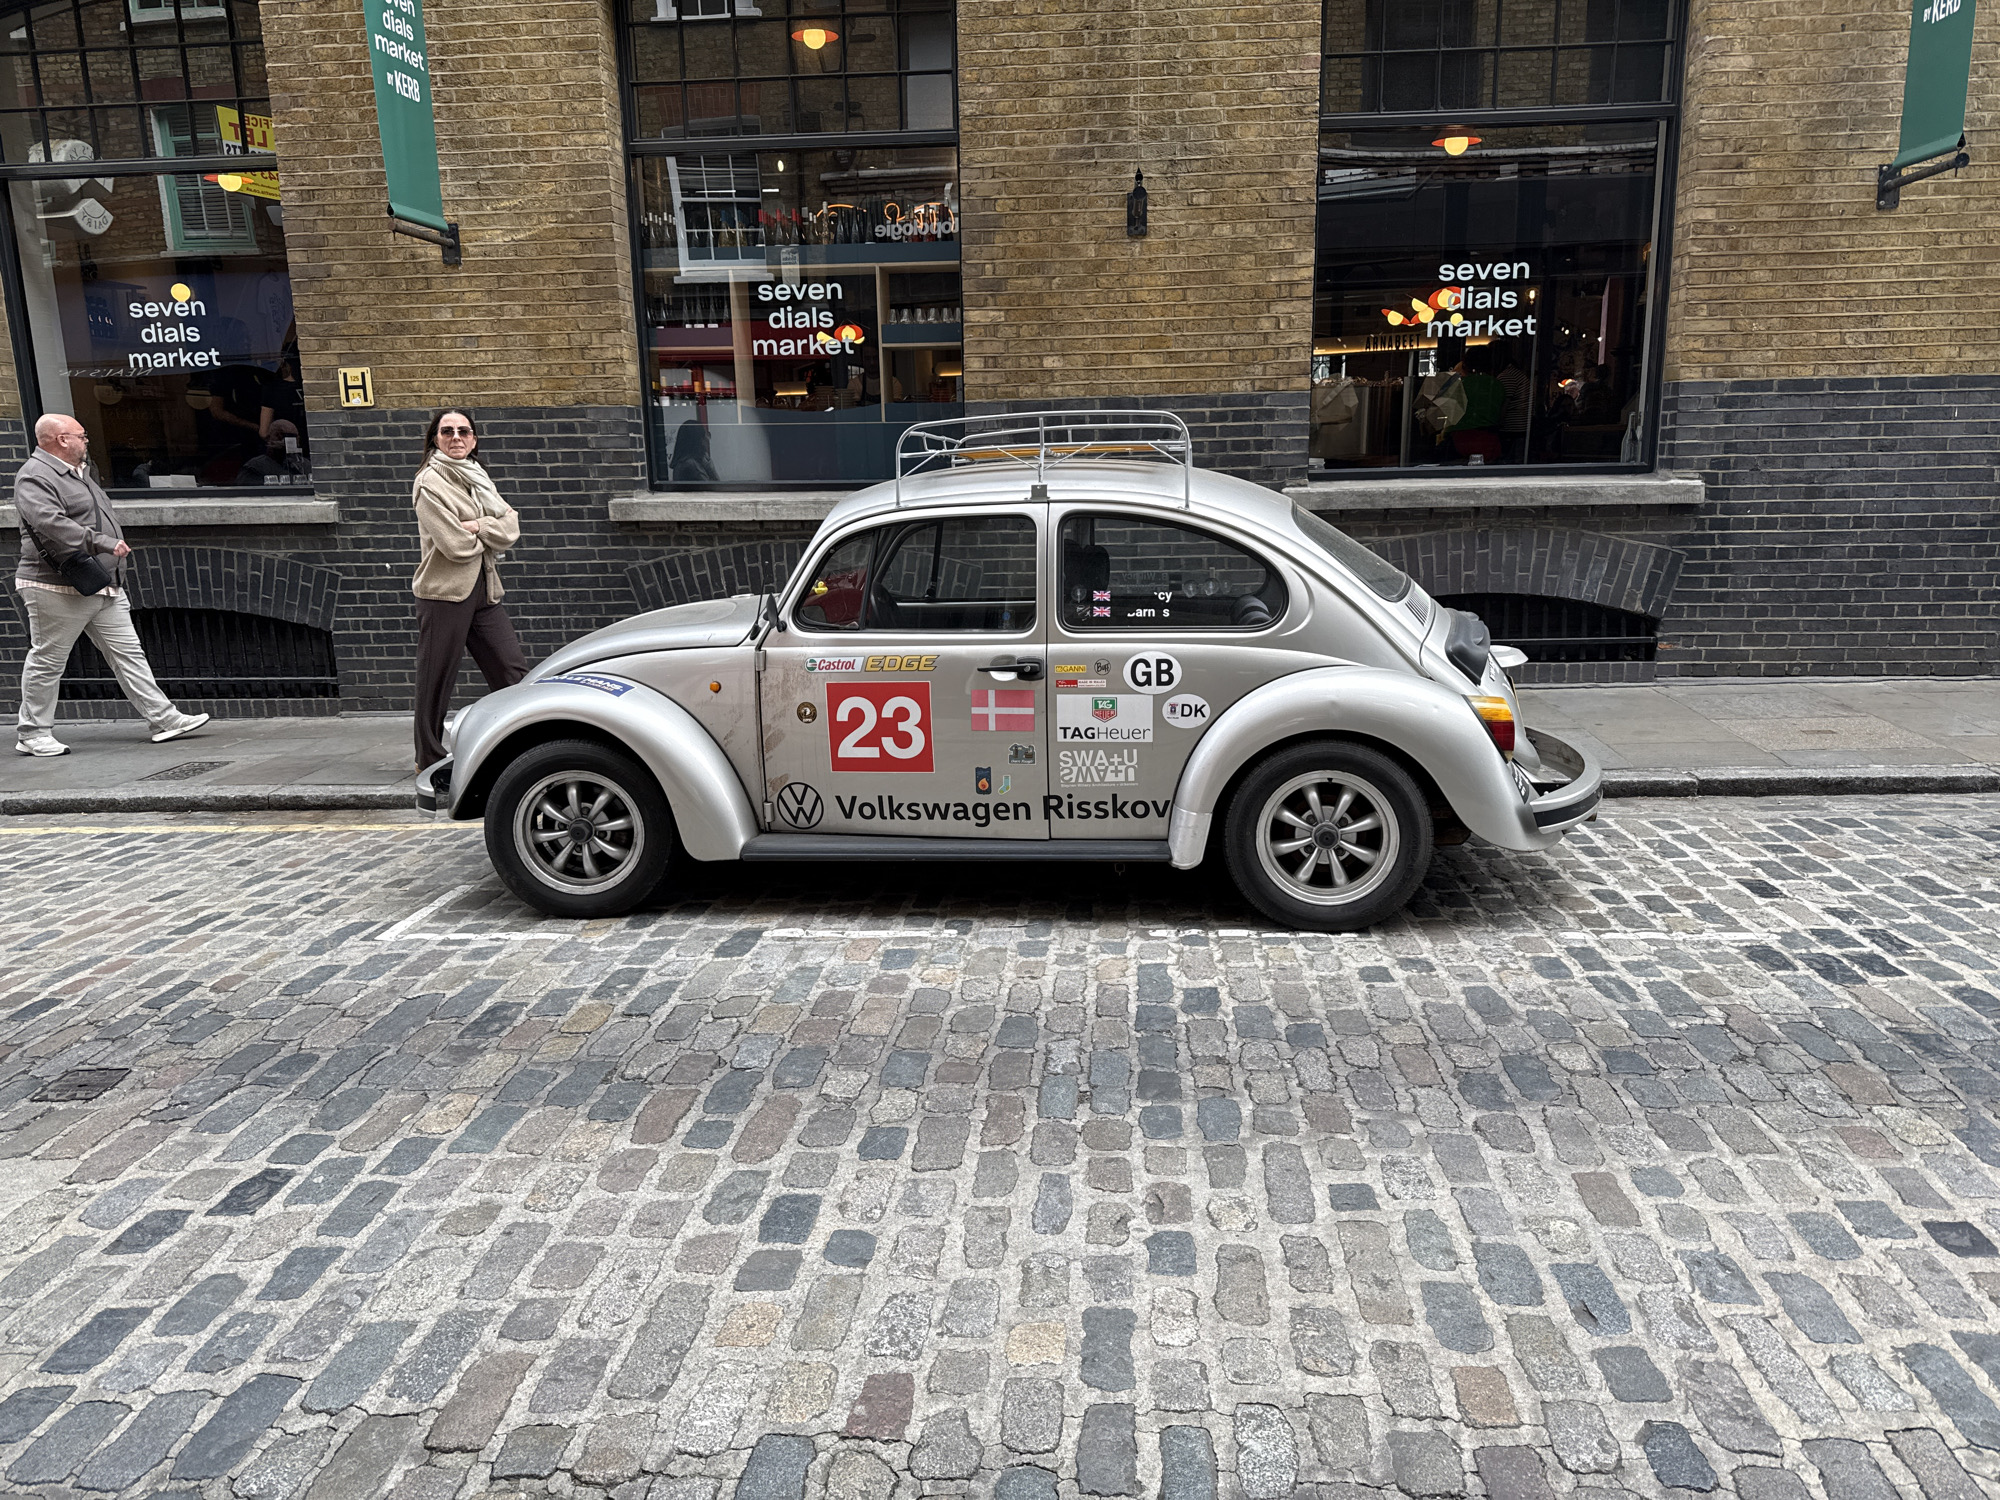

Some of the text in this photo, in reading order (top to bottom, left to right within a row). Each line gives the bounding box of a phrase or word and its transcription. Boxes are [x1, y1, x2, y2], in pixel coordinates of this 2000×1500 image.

[382, 9, 415, 41] dials
[374, 33, 425, 71] market
[394, 70, 421, 102] KERB
[1438, 262, 1530, 281] seven
[757, 282, 843, 301] seven
[1448, 286, 1518, 309] dials
[128, 300, 207, 318] seven
[768, 305, 834, 329] dials
[141, 321, 201, 343] dials
[1426, 314, 1537, 338] market
[752, 333, 855, 356] market
[128, 347, 221, 368] market
[343, 371, 369, 403] H
[817, 655, 940, 672] Castrol EDGE
[1130, 658, 1175, 688] GB
[1094, 709, 1116, 720] HEUER
[1097, 700, 1113, 709] TAG
[1181, 703, 1207, 718] DK
[836, 696, 926, 759] 23
[1059, 748, 1138, 768] SWA+U
[835, 793, 1171, 827] Volkswagen Risskov
